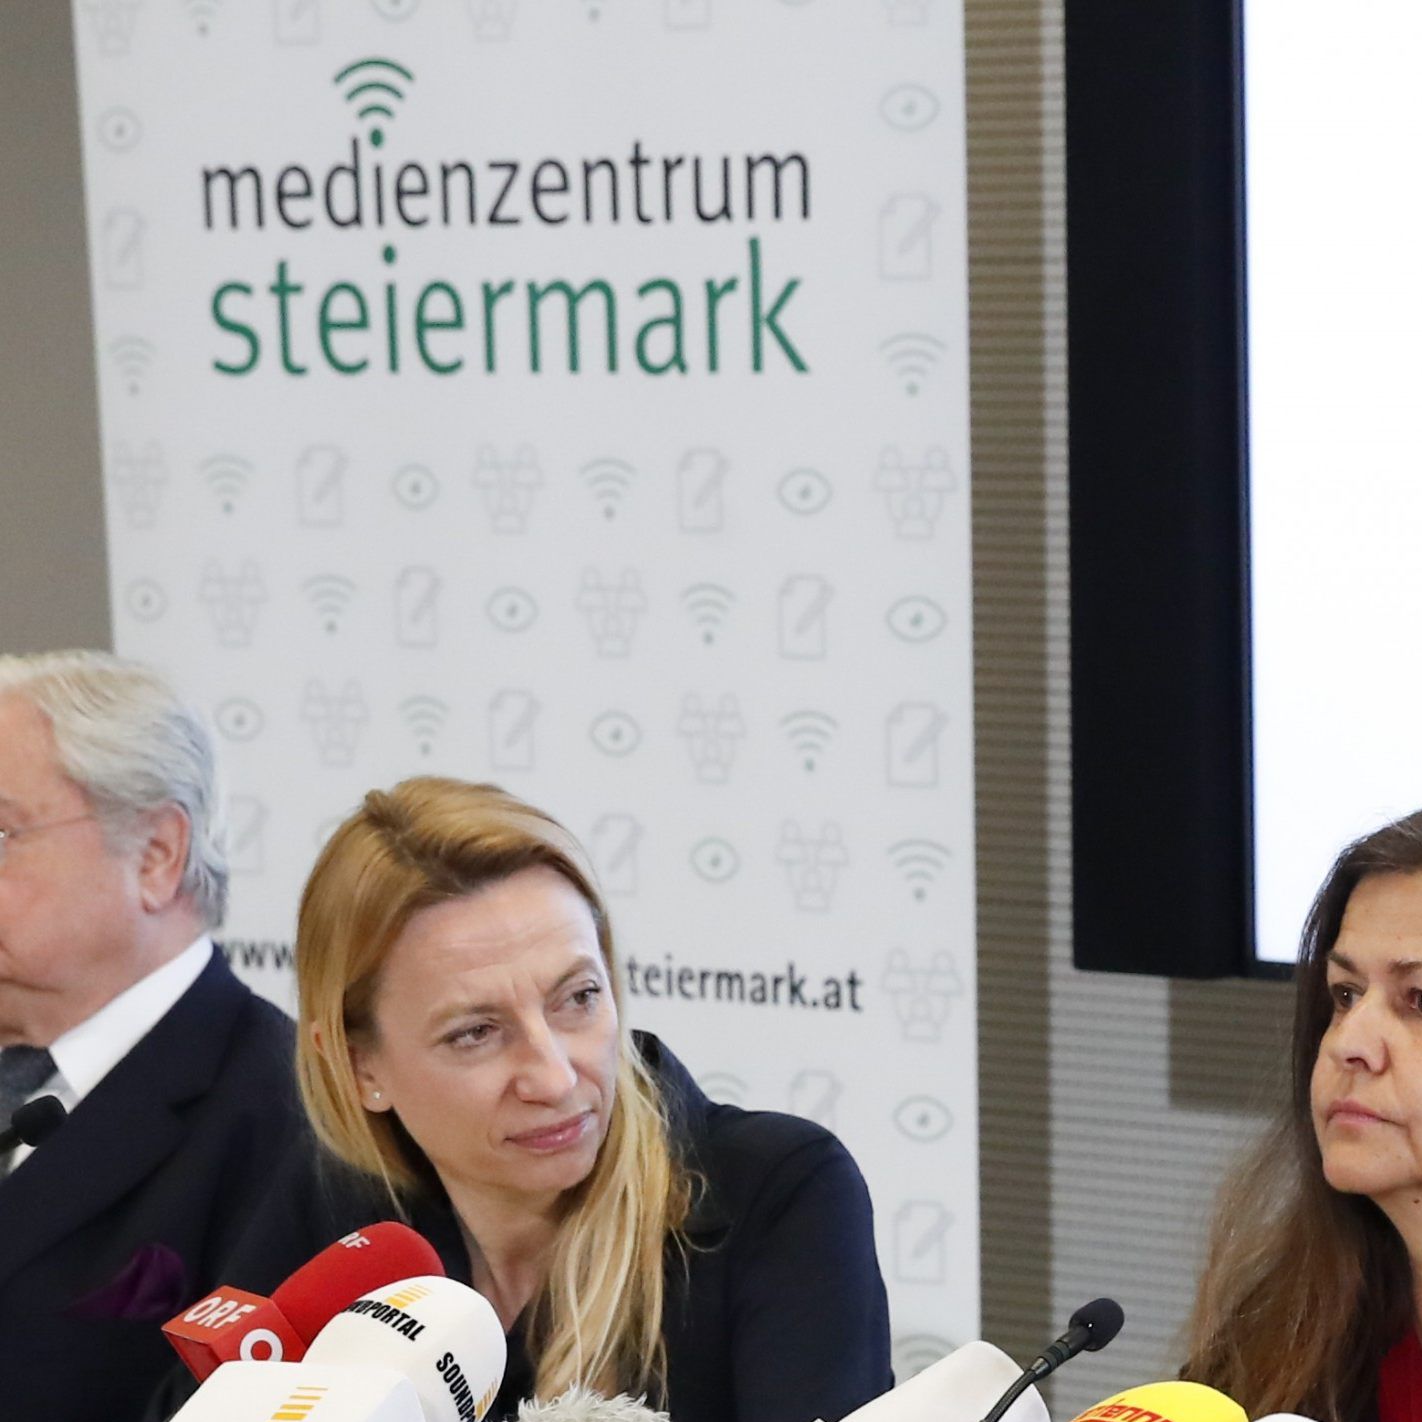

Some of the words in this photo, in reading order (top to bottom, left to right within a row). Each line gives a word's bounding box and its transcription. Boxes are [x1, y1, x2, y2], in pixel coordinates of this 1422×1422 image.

[203, 128, 811, 230] medienzentrum
[211, 236, 811, 377] steiermark
[337, 1231, 371, 1248] RF
[183, 1297, 257, 1329] ORF
